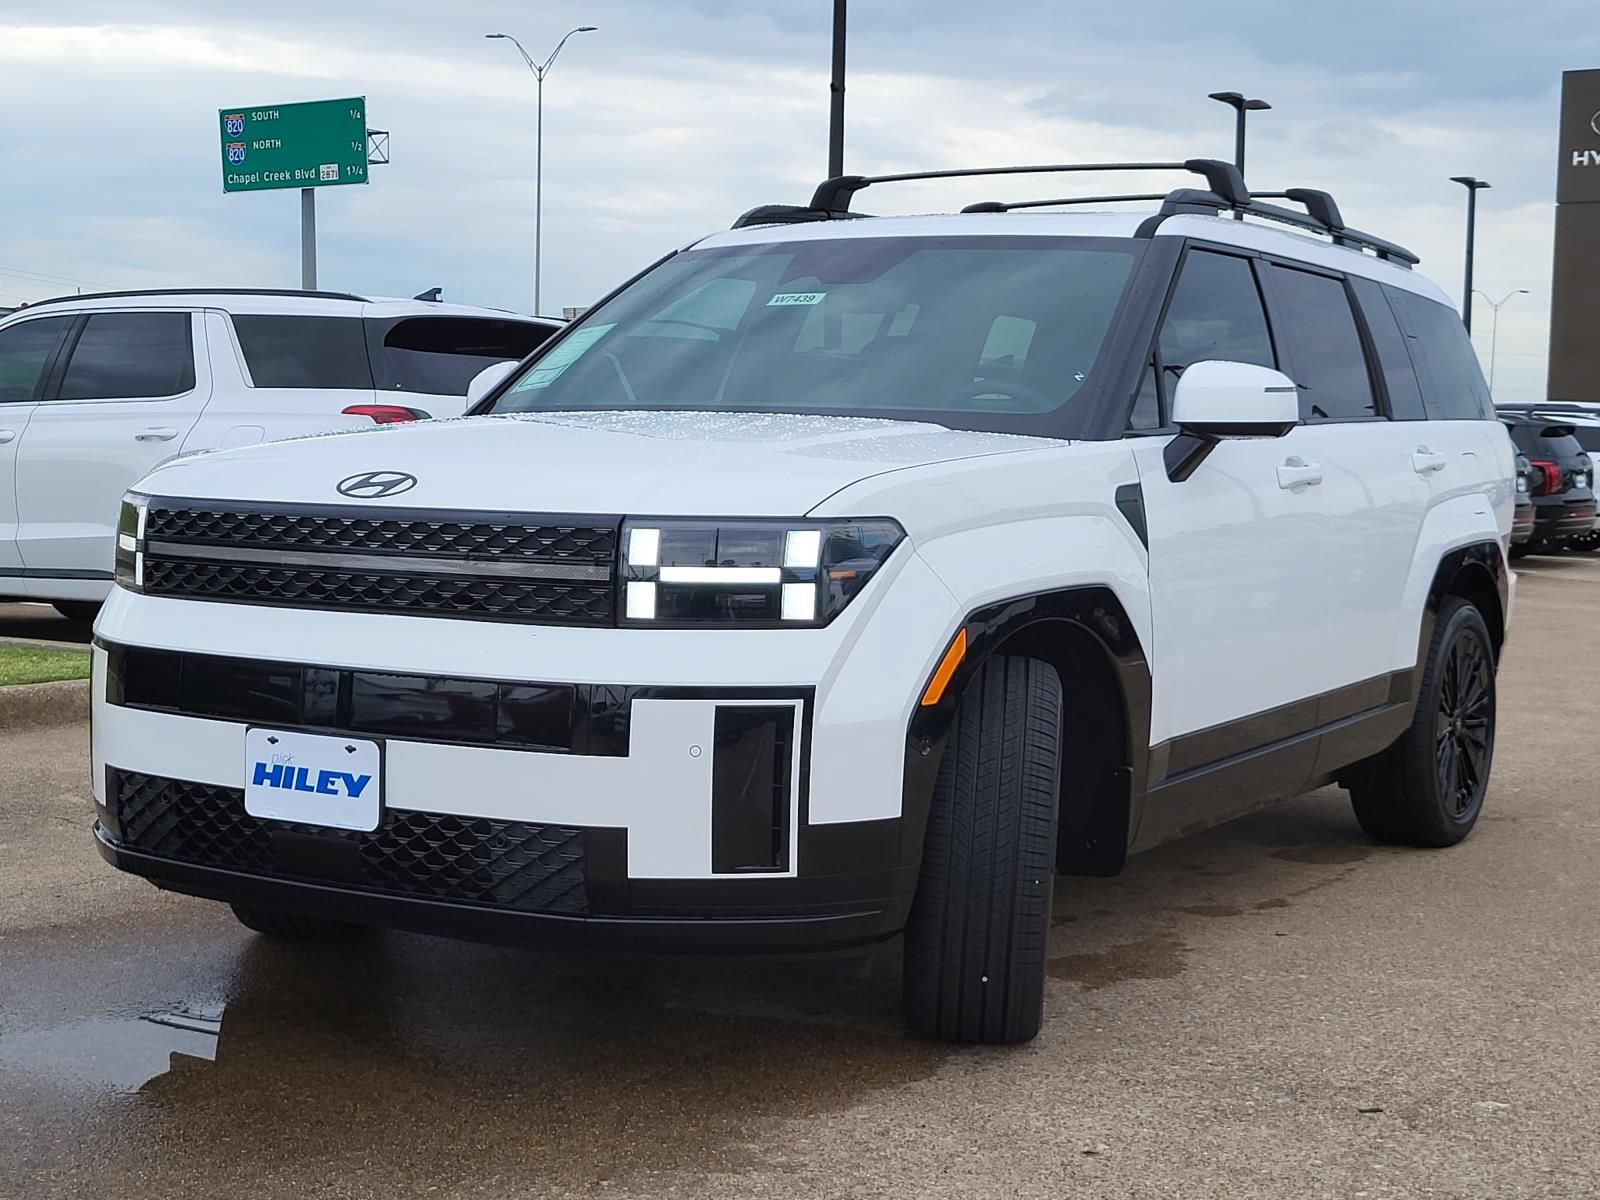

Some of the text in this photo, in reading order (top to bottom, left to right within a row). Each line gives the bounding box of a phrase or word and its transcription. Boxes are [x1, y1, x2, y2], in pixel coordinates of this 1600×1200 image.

[227, 120, 244, 133] 820
[252, 110, 279, 121] SOUTH
[229, 149, 244, 161] 820
[253, 139, 281, 150] NORTH
[228, 172, 259, 185] Chapel
[264, 170, 291, 182] Creek
[295, 168, 316, 180] Blvd
[321, 168, 338, 180] 2871
[775, 295, 816, 303] W7439
[252, 761, 372, 798] HILEY
